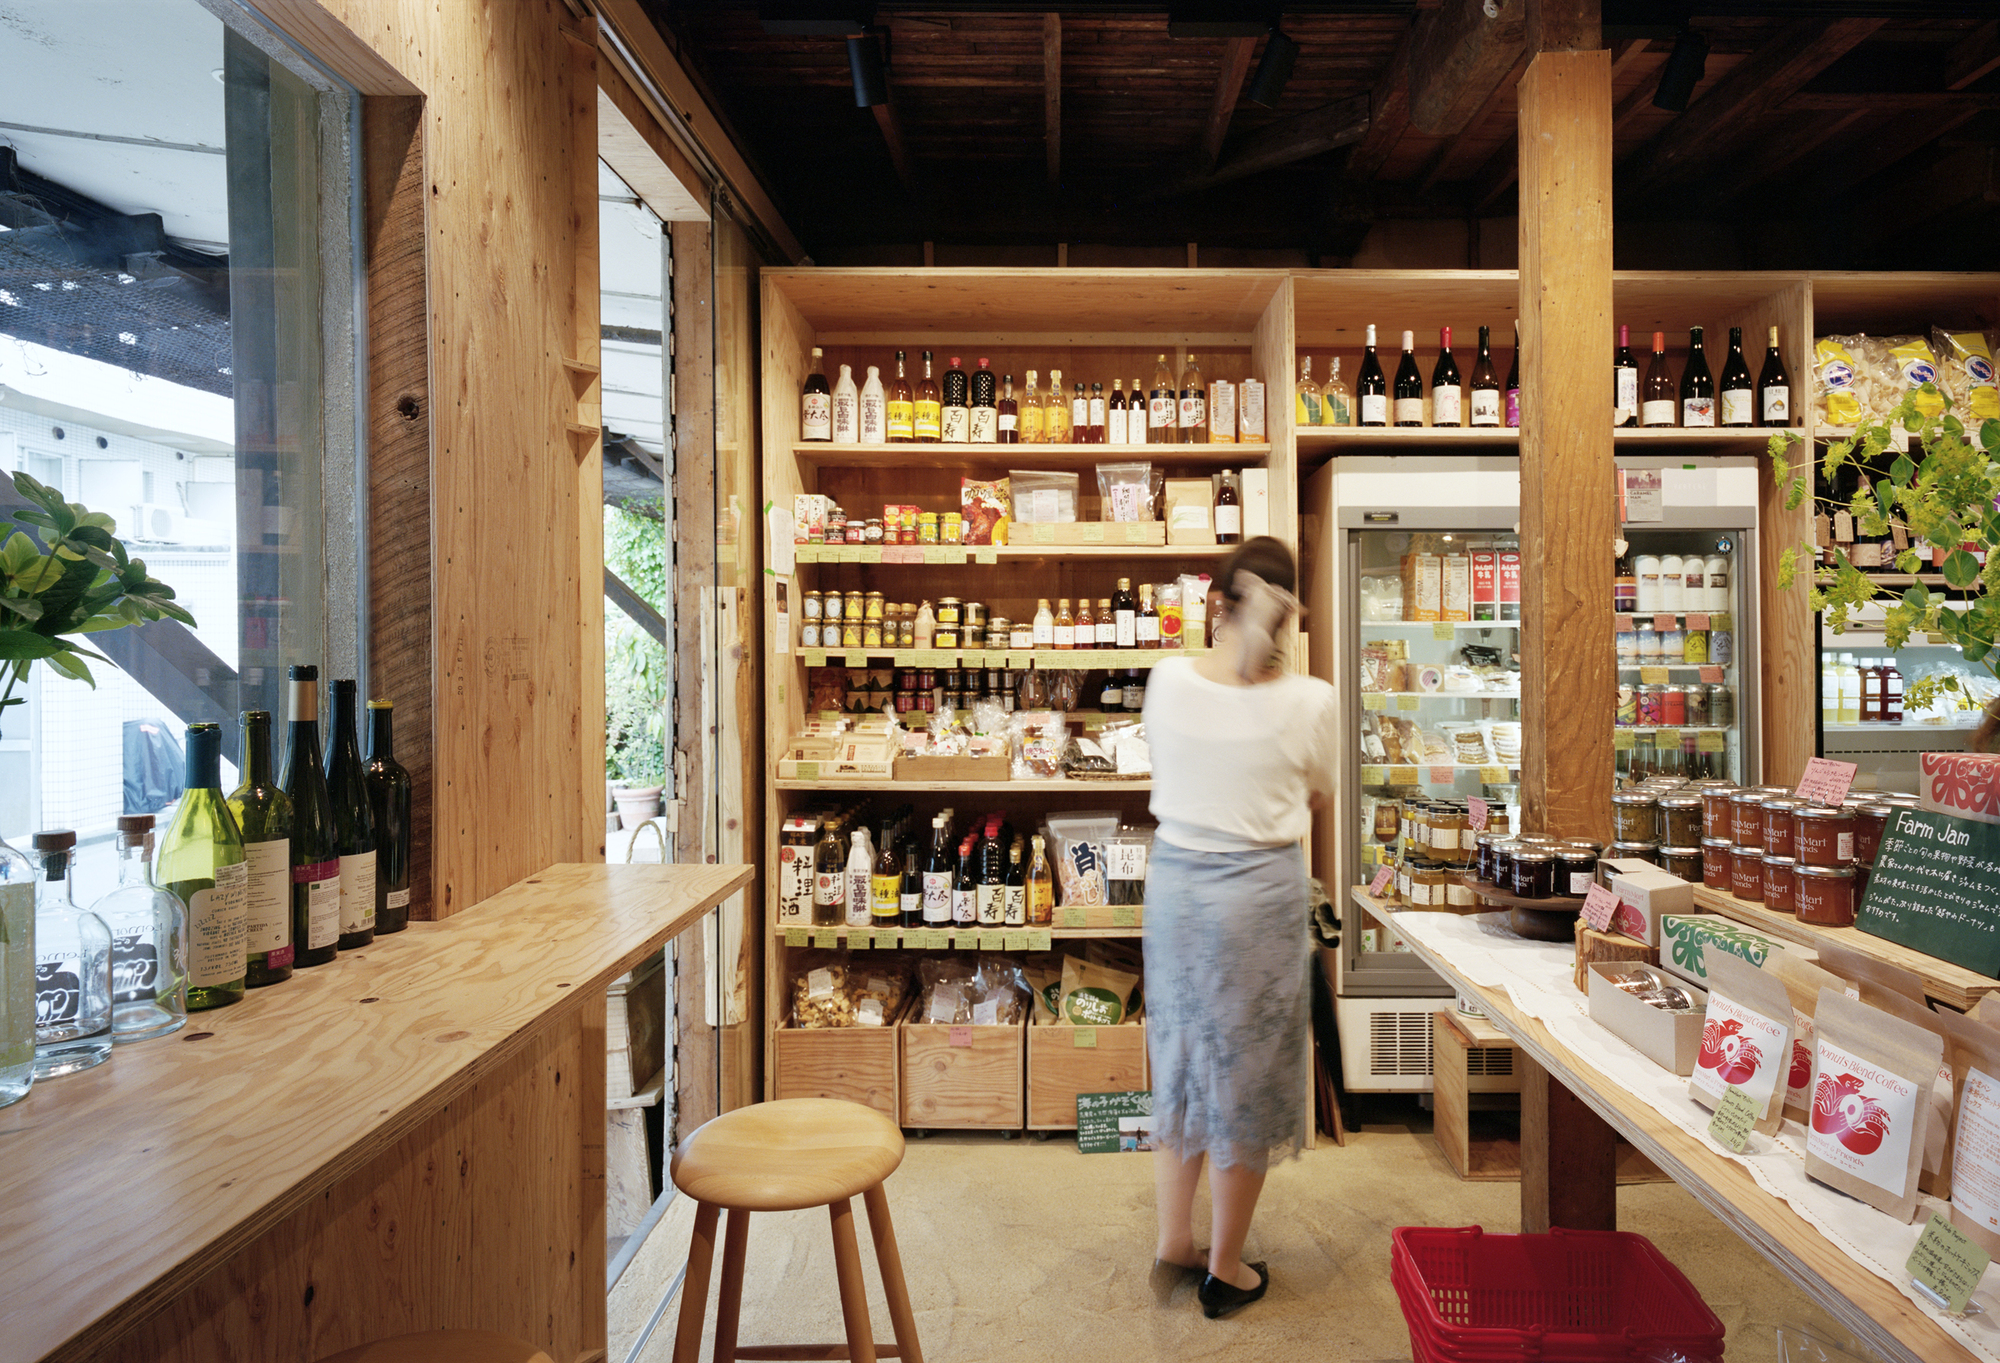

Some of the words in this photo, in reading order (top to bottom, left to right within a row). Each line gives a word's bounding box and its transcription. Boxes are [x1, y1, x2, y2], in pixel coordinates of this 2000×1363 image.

[944, 409, 963, 438] 百寿
[972, 409, 990, 438] 百寿
[1477, 571, 1491, 579] 牛乳
[1504, 571, 1518, 579] 牛乳
[1731, 819, 1760, 831] rmMart
[1895, 811, 1934, 839] Farm
[1937, 823, 1970, 846] Jam
[1795, 835, 1828, 847] rmMart
[1120, 848, 1135, 876] 昆布
[782, 856, 813, 916] 料理酒
[1732, 872, 1759, 884] rmMart
[210, 892, 228, 902] LAZY
[984, 888, 1004, 920] 百寿
[1006, 888, 1024, 920] 百寿
[1795, 892, 1824, 905] rmMart
[1076, 997, 1109, 1015] のりしお
[1709, 995, 1734, 1013] Donuts
[1733, 1008, 1752, 1023] Blend
[1752, 1015, 1780, 1037] Coffee
[1819, 1044, 1849, 1068] Donuts
[1848, 1060, 1876, 1081] Blend
[1875, 1073, 1908, 1096] Coffee
[1971, 1077, 1992, 1093] かまパン
[1836, 1148, 1864, 1167] Friends
